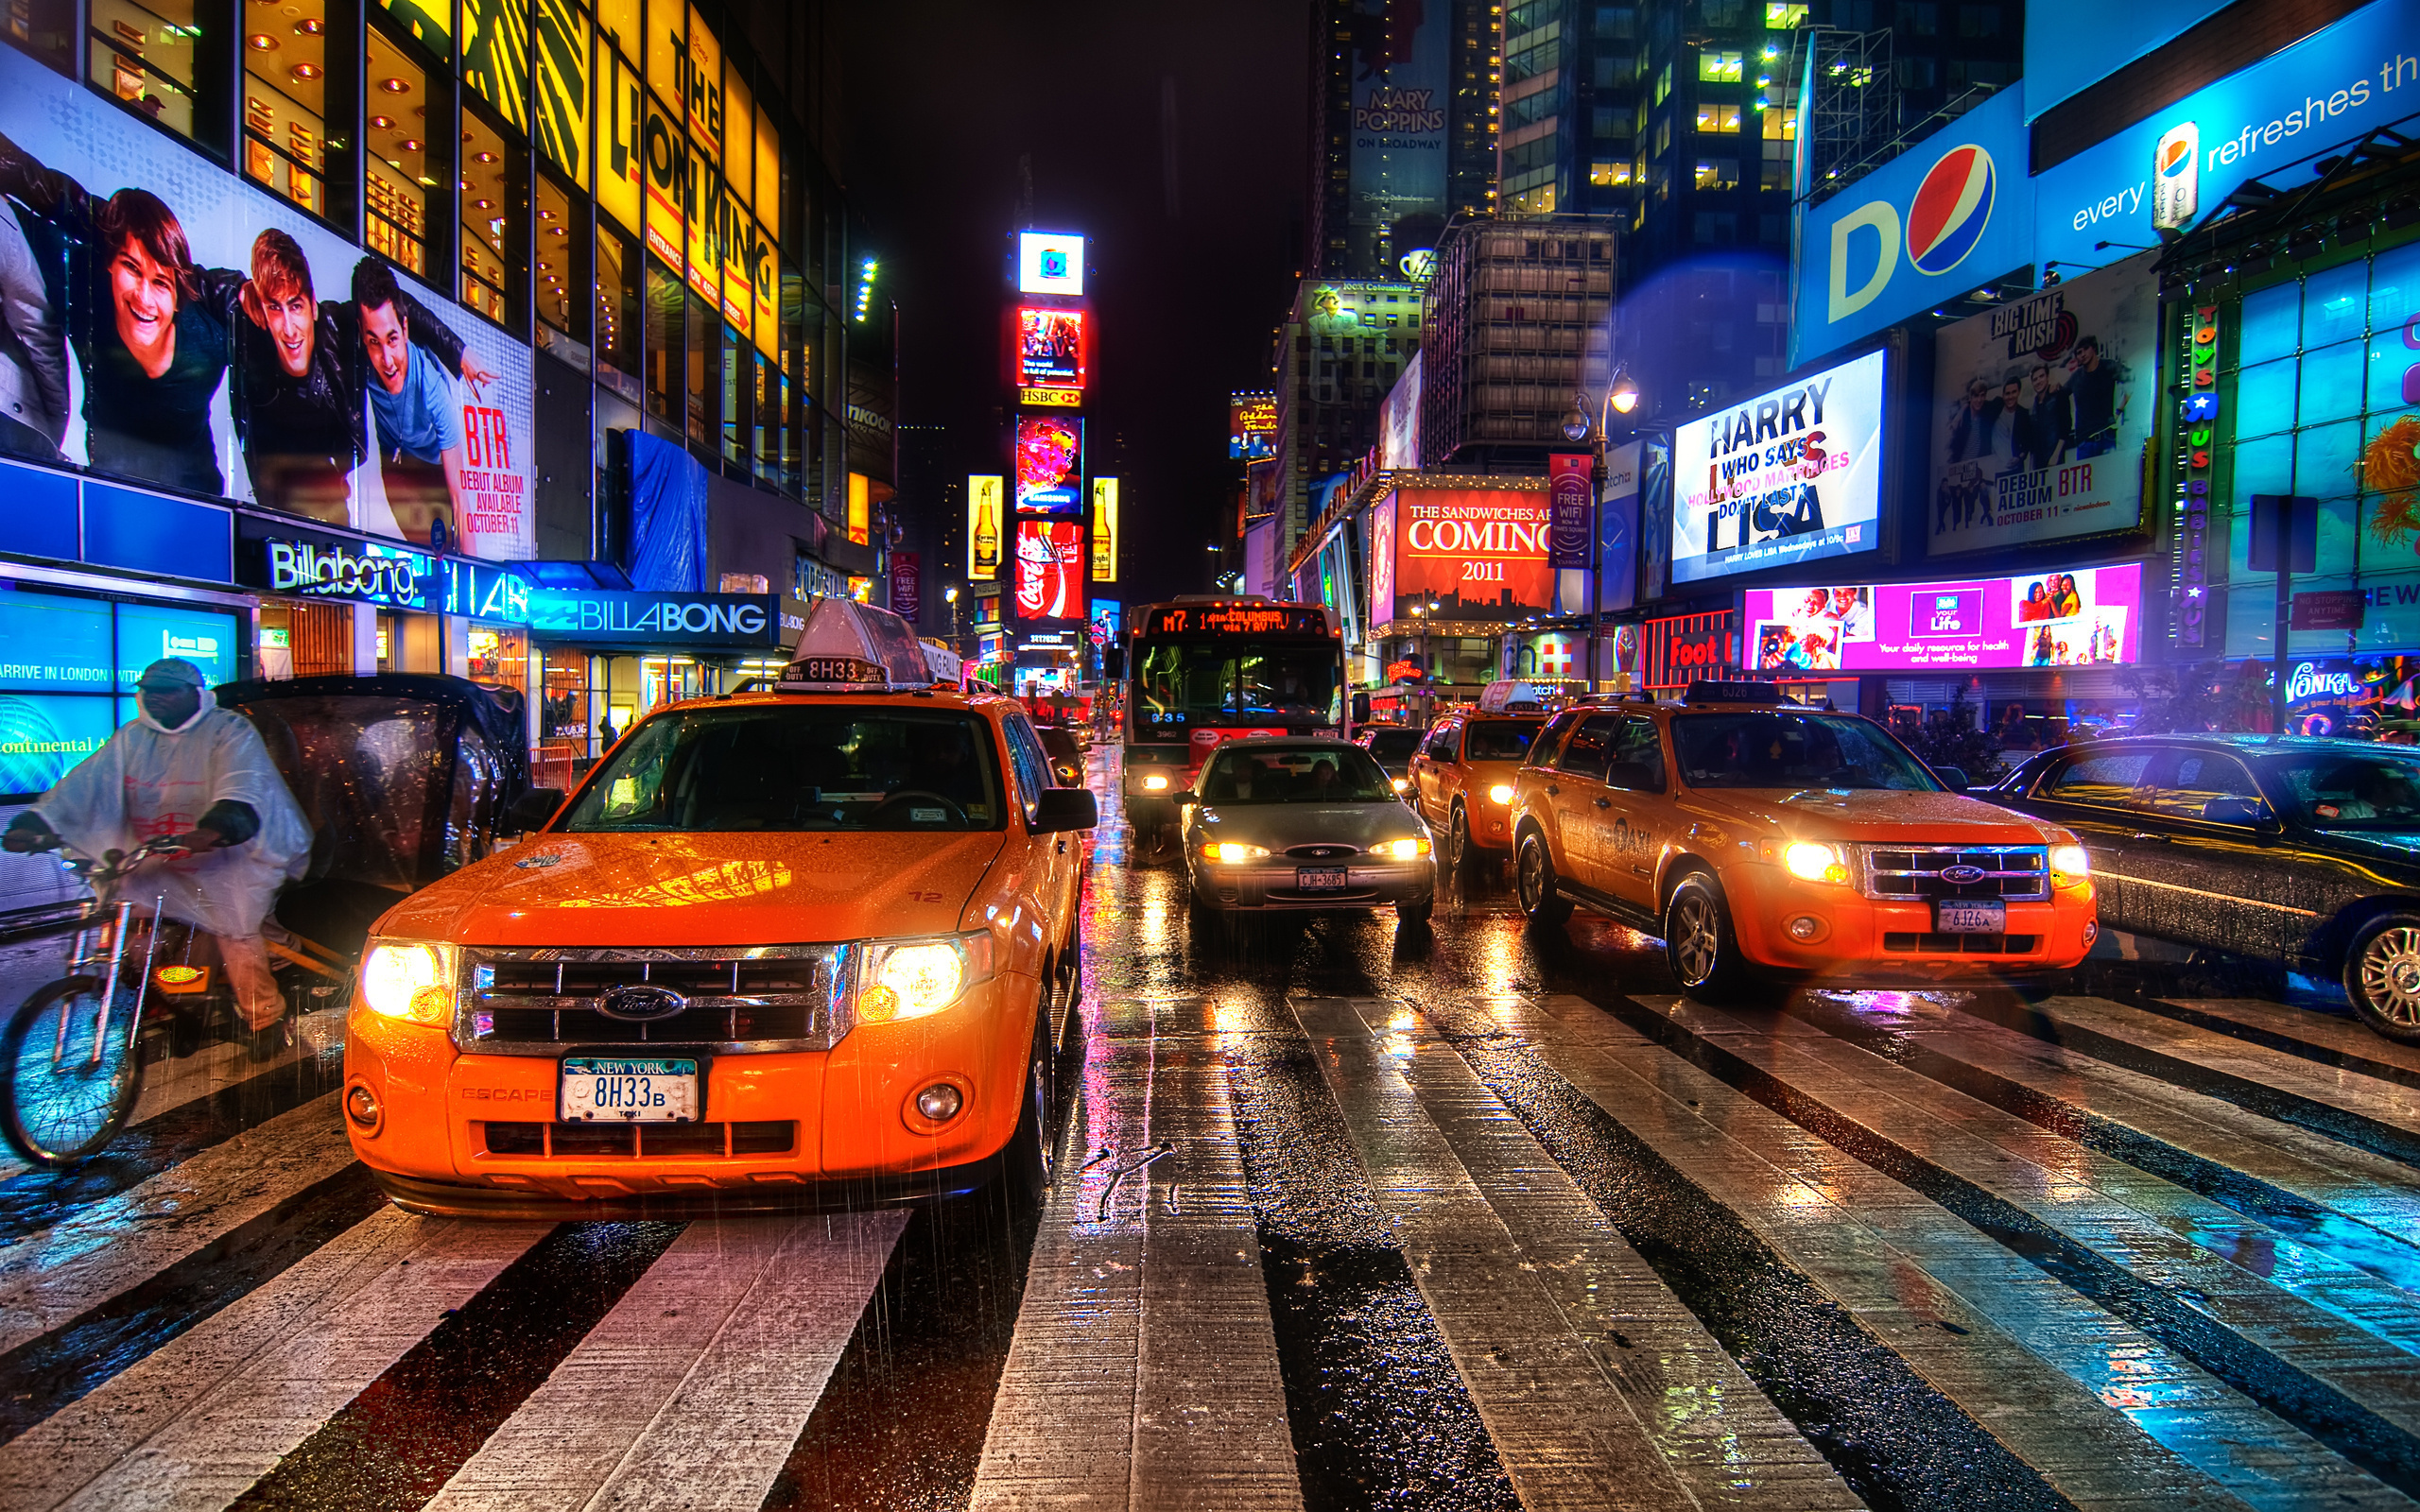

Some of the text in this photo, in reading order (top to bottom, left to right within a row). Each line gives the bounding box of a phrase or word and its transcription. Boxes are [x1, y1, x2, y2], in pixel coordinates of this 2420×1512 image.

[670, 28, 719, 141] THE
[1370, 88, 1431, 111] MARY
[1355, 108, 1443, 132] POPPINS
[1357, 138, 1442, 149] ON BROADWAY
[610, 26, 770, 302] LION KING
[2073, 180, 2146, 232] every
[2208, 79, 2371, 172] refreshes
[648, 227, 740, 322] ENTRANCE ON 45TH STREET
[1343, 283, 1365, 291] 100%
[1994, 292, 2063, 336] BIG TIME
[2014, 318, 2056, 353] RUSH
[2194, 305, 2217, 387] TOYS
[1021, 390, 1058, 403] HSBC
[1253, 404, 1274, 412] The
[1710, 377, 1832, 459] HARRY
[463, 404, 510, 470] BTR
[2191, 429, 2210, 469] US
[1721, 438, 1808, 480] WHO SAYS
[459, 470, 525, 494] DEBUT ALBUM
[1688, 451, 1850, 509] HOLLYWOOD MARRIAGES
[1998, 470, 2048, 495] DEBUT
[2058, 463, 2092, 497] BTR
[476, 492, 522, 514] AVAILABLE
[1028, 494, 1070, 504] SAMSUNG
[1557, 493, 1584, 506] FREE
[1997, 486, 2052, 511] ALBUM
[1409, 506, 1533, 520] THE SANDWICHES
[1559, 506, 1582, 519] WIFI
[1719, 497, 1756, 520] DON'T
[1996, 506, 2058, 526] OCTOBER 11
[466, 513, 519, 534] OCTOBER 11
[1569, 526, 1587, 535] SQUARE
[1724, 552, 1744, 564] HARRY
[1744, 549, 1764, 561] LOVES
[1764, 545, 1778, 558] LISA
[1778, 540, 1817, 555] Wednesdays
[1818, 538, 1825, 546] at
[1461, 561, 1505, 581] 2011
[896, 576, 915, 585] FREE
[2315, 594, 2359, 605] STOPPING
[580, 600, 767, 634] BILLABONG
[1230, 610, 1280, 622] COLUMBUS
[1936, 610, 1958, 618] your
[2308, 607, 2347, 615] ANYTIME
[1163, 610, 1186, 631] M7
[1253, 623, 1268, 631] AV
[1930, 616, 1962, 631] Life
[1669, 636, 1717, 667] Foot
[1879, 640, 2010, 655] Your daily resource for health
[1910, 652, 1978, 664] and well-being
[44, 665, 57, 680] IN
[60, 667, 108, 681] LONDON
[786, 673, 804, 681] DUTY
[809, 662, 856, 679] 8H33
[863, 674, 881, 682] DUTY
[1722, 686, 1747, 697] 6J26
[1302, 874, 1341, 886] CJH 3685
[617, 994, 660, 1011] Ford
[596, 1062, 666, 1074] NEW YORK
[461, 1088, 554, 1103] ESCAPE
